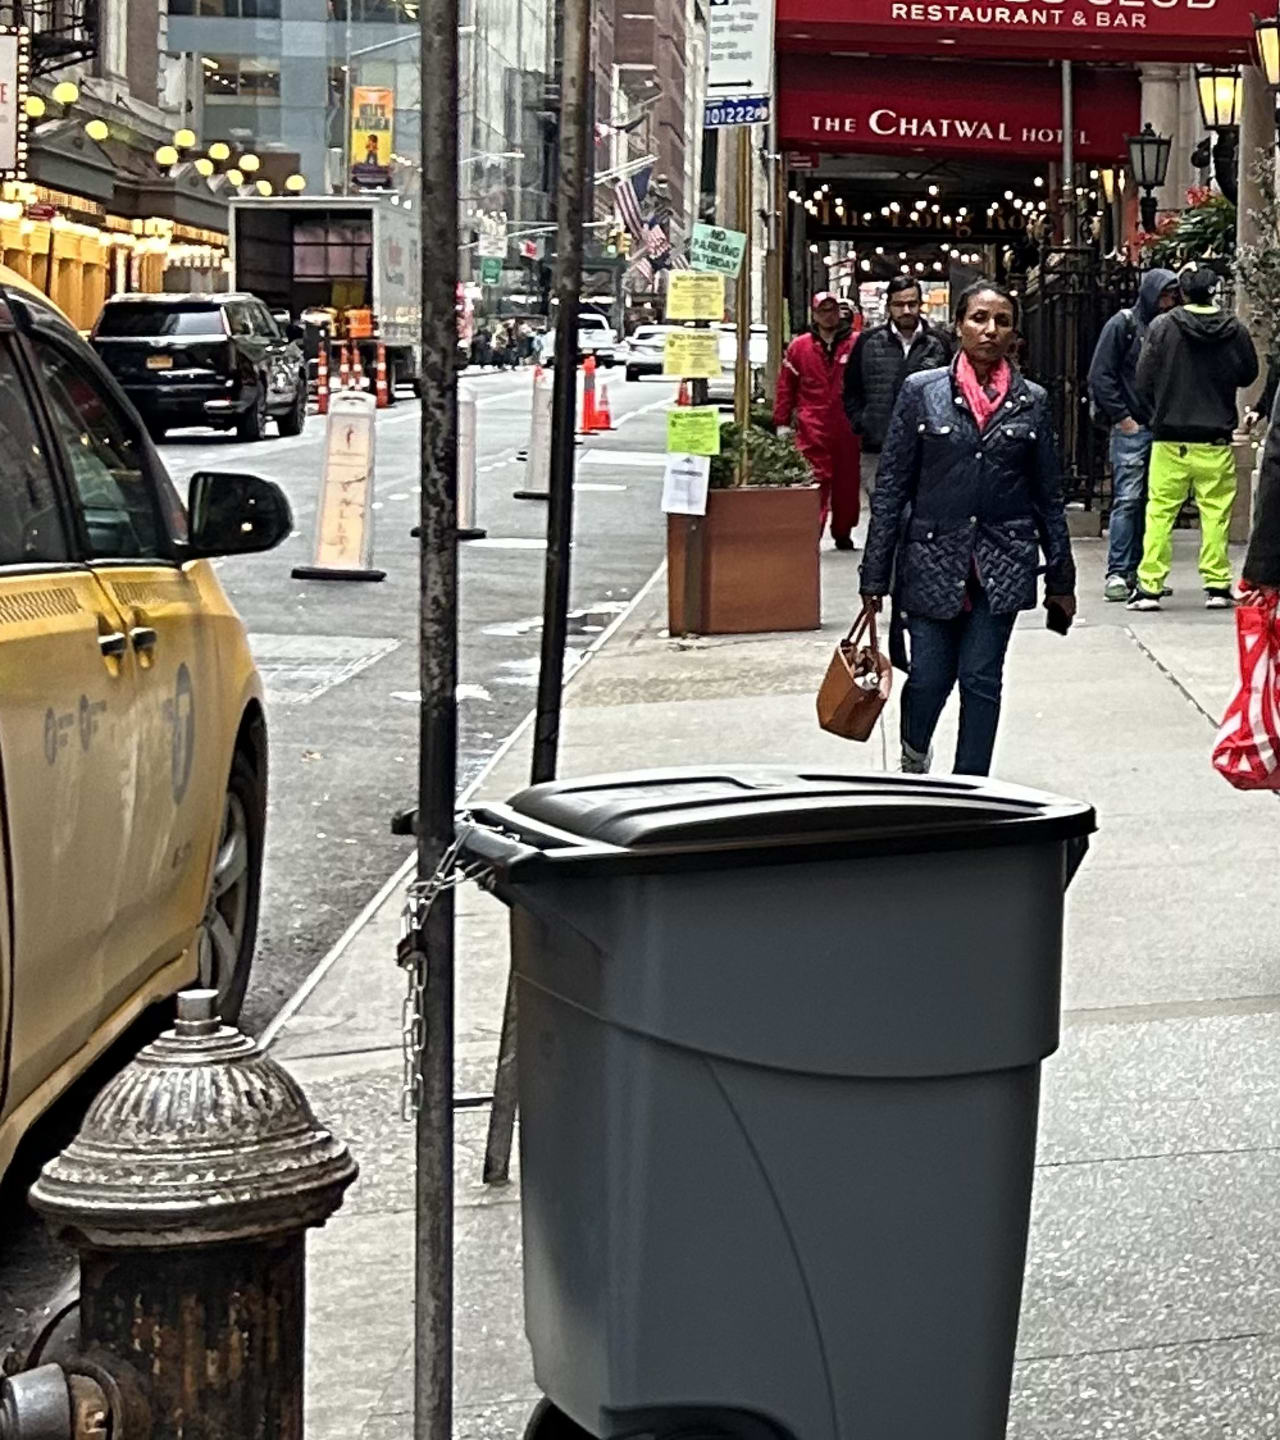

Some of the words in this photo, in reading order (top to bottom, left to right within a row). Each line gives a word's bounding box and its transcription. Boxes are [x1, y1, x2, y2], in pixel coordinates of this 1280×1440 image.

[892, 3, 1064, 26] RESTAURANT
[1072, 10, 1087, 27] &
[1096, 11, 1147, 29] BAR
[811, 115, 857, 133] THE
[868, 109, 1012, 143] CHATWAL
[1021, 127, 1091, 145] HOTL
